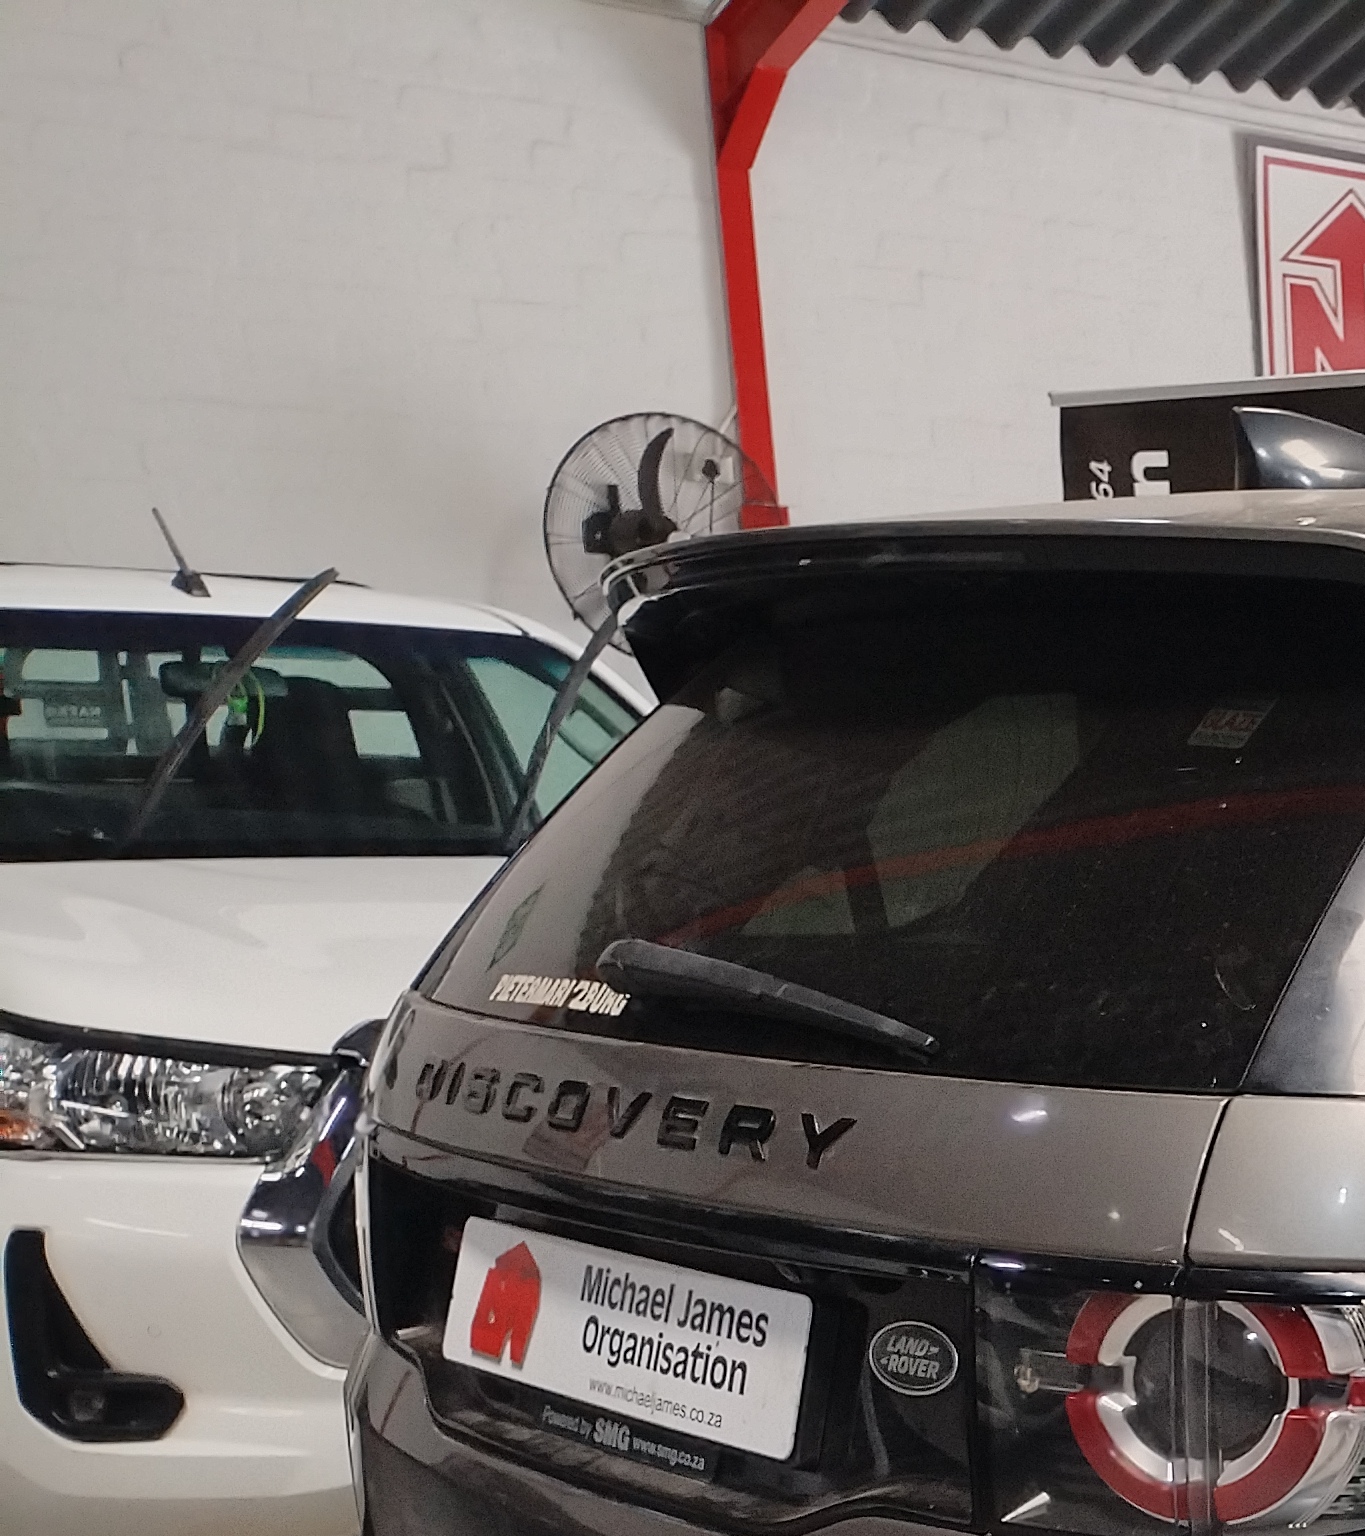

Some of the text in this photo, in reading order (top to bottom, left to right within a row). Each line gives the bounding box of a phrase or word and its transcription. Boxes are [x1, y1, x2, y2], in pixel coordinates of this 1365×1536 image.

[415, 1058, 858, 1170] DISCOVERY
[580, 1264, 769, 1348] Michael James
[582, 1314, 748, 1396] Organisation
[886, 1334, 931, 1357] LAND
[887, 1353, 941, 1380] ROVER
[589, 1377, 723, 1428] www.michaeljames.co.za
[593, 1416, 631, 1451] SMG
